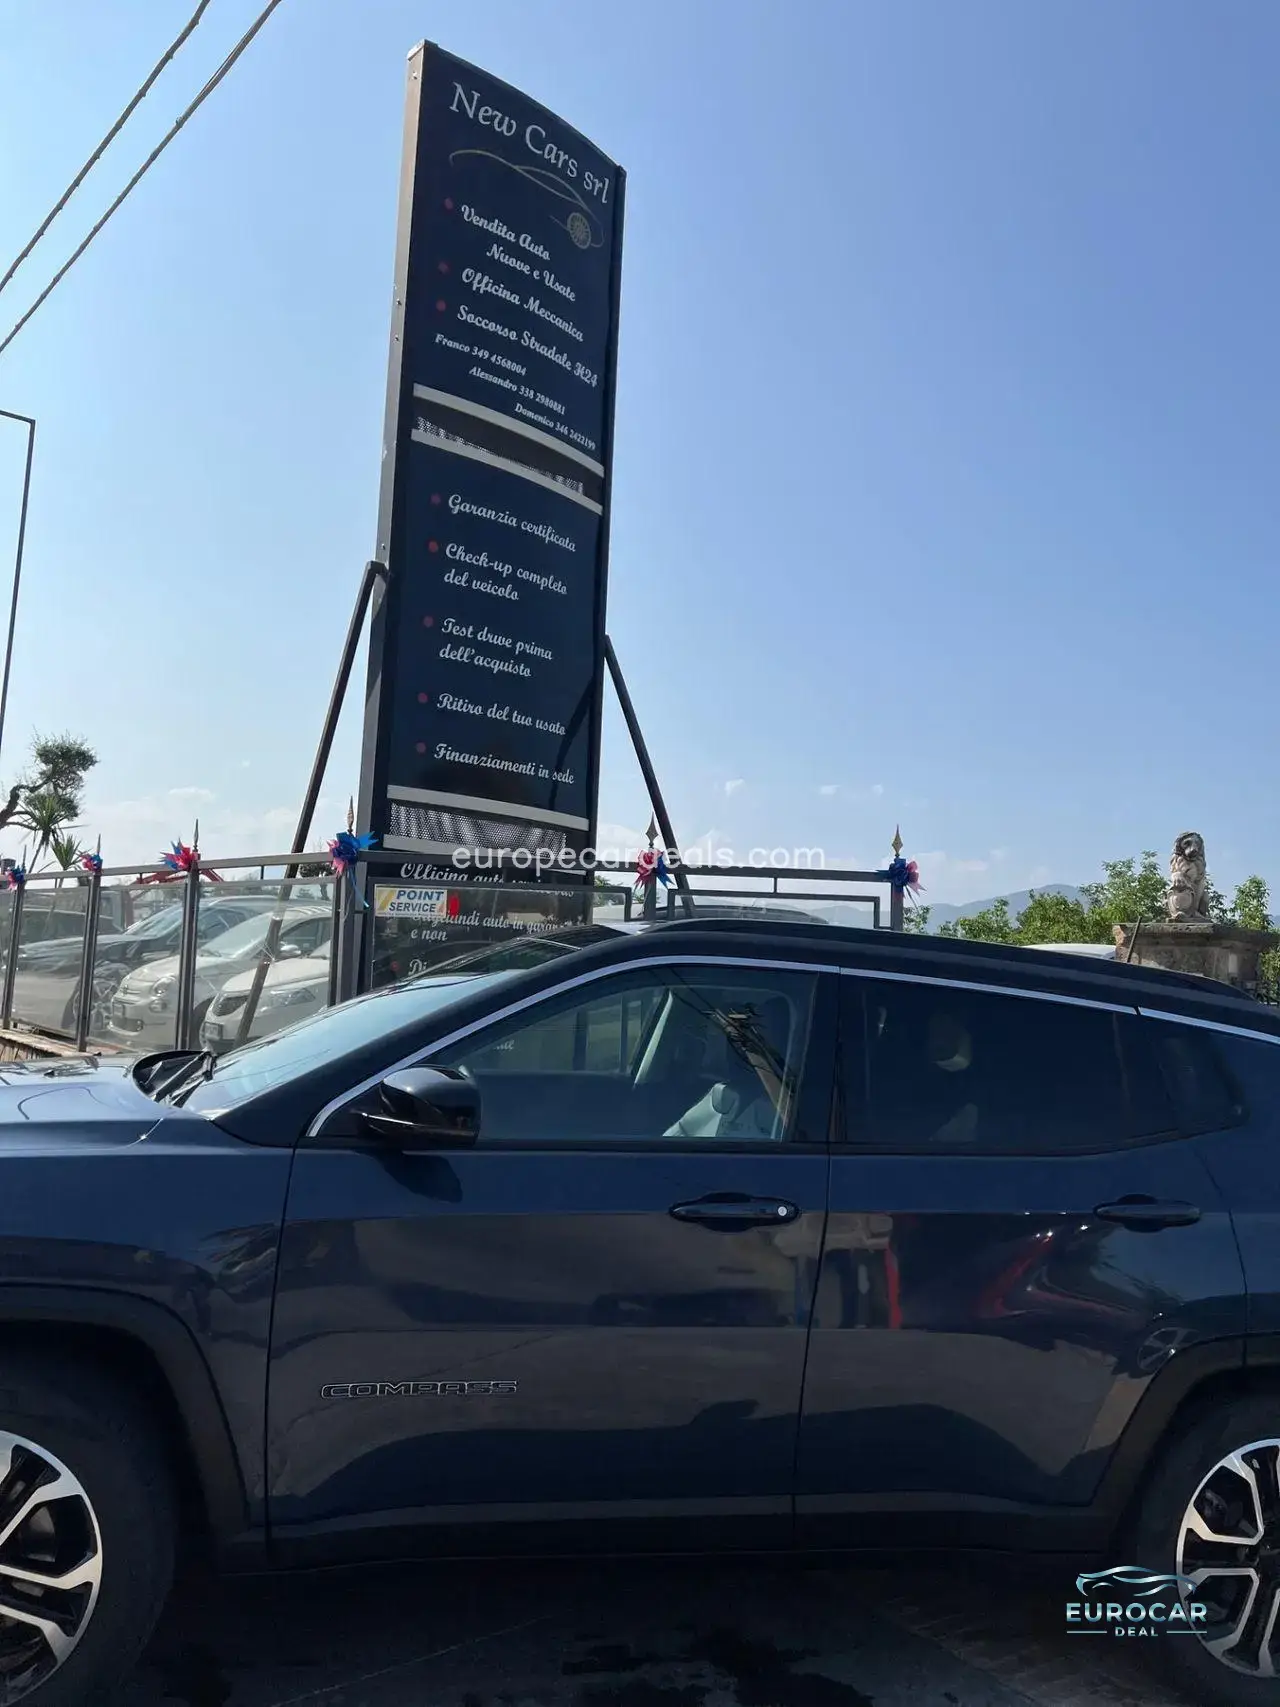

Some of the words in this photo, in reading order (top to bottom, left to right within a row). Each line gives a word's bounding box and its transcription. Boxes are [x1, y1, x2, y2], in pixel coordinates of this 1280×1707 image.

[450, 82, 517, 136] New
[525, 125, 578, 178] Cars
[583, 171, 610, 203] srl
[461, 205, 516, 242] Vendita
[519, 234, 550, 260] Auto
[486, 244, 530, 275] Nuove
[533, 270, 540, 280] e
[543, 270, 576, 301] Usate
[462, 268, 520, 304] Officina
[524, 297, 584, 342] Meccanica
[435, 333, 470, 353] Franco
[471, 347, 489, 360] 349
[490, 354, 527, 376] 4568004
[457, 305, 518, 341] Soccorso
[521, 331, 572, 371] Stradale
[574, 362, 598, 387] H24
[469, 366, 517, 392] Alessandro
[519, 385, 535, 399] 338
[515, 403, 554, 428] Domenico
[448, 494, 518, 527] Garanzia
[521, 521, 576, 552] certificata
[444, 569, 469, 587] del
[472, 578, 519, 601] veicolo
[445, 543, 512, 577] Check-up
[517, 567, 567, 595] completo
[441, 618, 474, 638] Test
[515, 641, 553, 660] prima
[439, 644, 532, 677] dell'acquisto
[437, 693, 484, 716] Ritiro
[487, 703, 509, 721] del
[512, 711, 533, 726] tuo
[535, 718, 566, 736] usato
[434, 743, 536, 776] Finanziamenti
[538, 765, 549, 779] in
[552, 768, 575, 784] sede
[389, 902, 436, 913] SERVICE
[397, 890, 444, 901] POINT
[411, 929, 418, 939] e
[422, 929, 448, 941] non
[483, 915, 509, 928] auto
[321, 1381, 517, 1399] COMPASS
